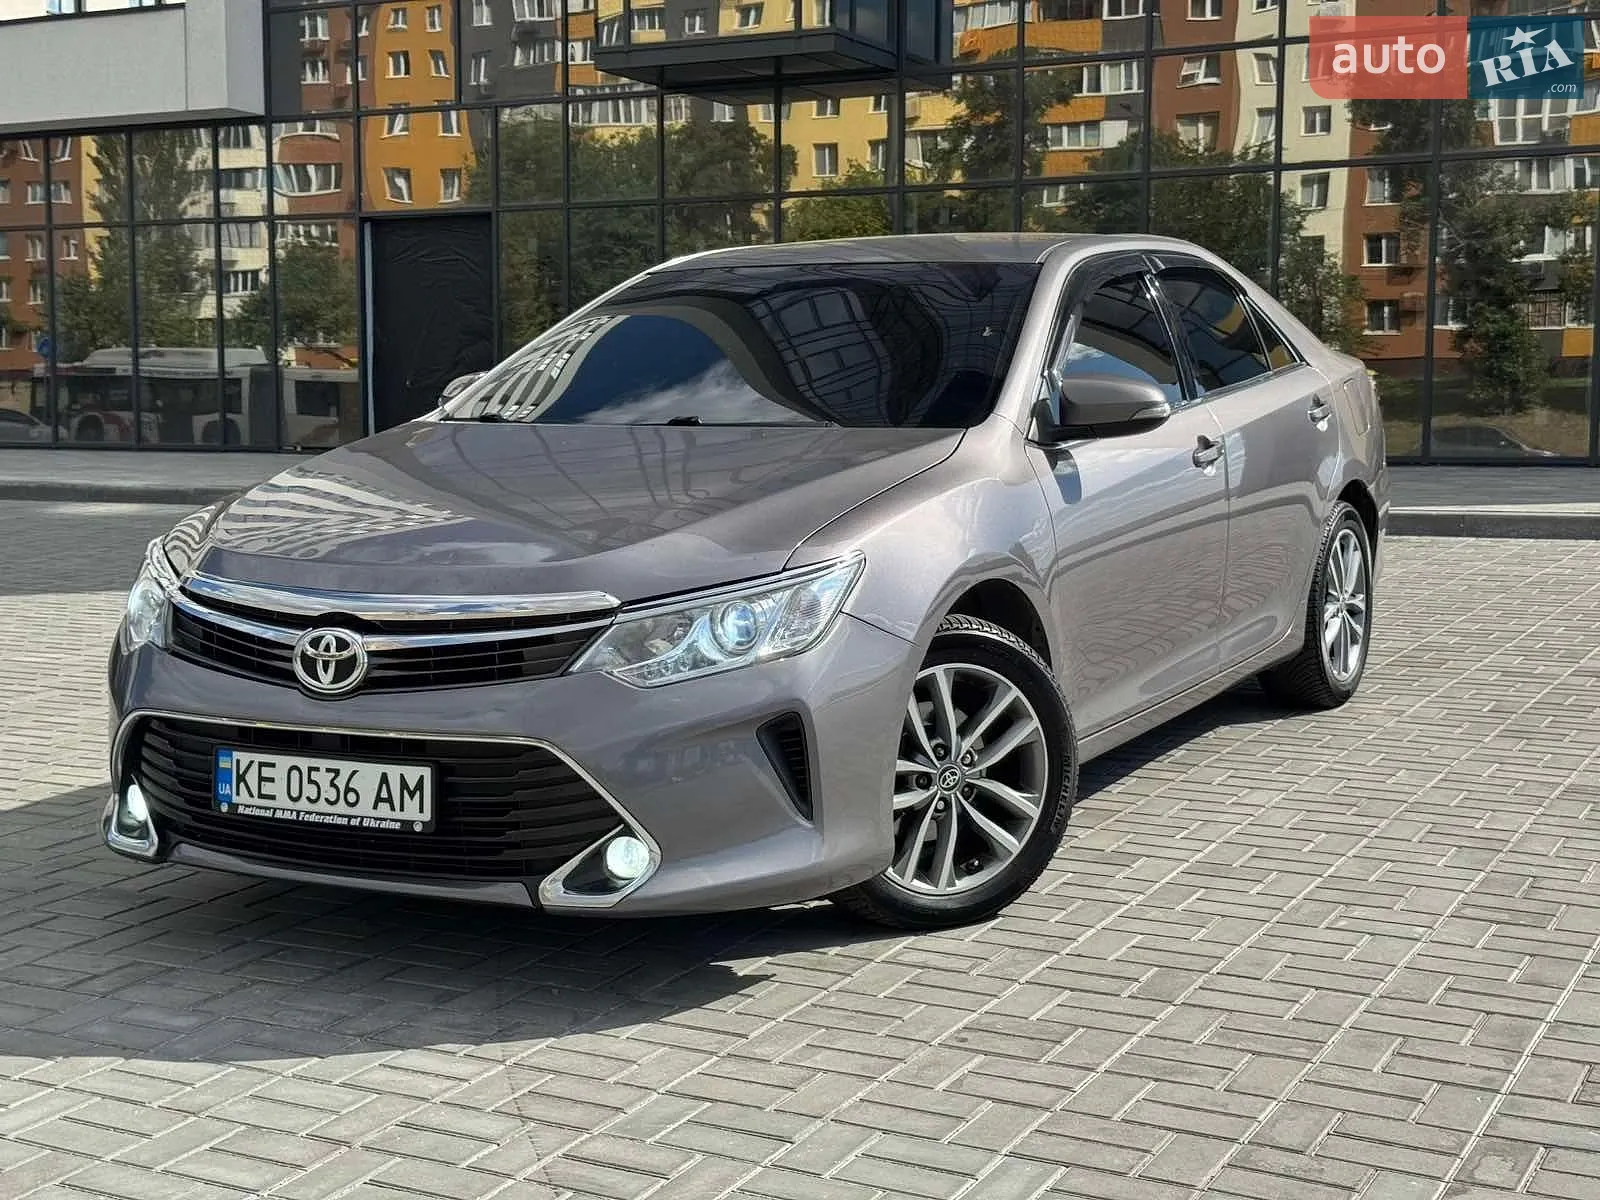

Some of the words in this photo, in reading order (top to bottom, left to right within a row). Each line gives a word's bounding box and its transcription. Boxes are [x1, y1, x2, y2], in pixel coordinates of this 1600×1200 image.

[218, 783, 231, 795] UA
[235, 758, 277, 801] KE
[286, 765, 360, 808] 0536
[372, 771, 424, 814] AM
[237, 805, 274, 817] National
[274, 807, 297, 820] MMA
[298, 811, 348, 825] Federation
[350, 817, 360, 826] of
[362, 818, 401, 829] Ukraine
